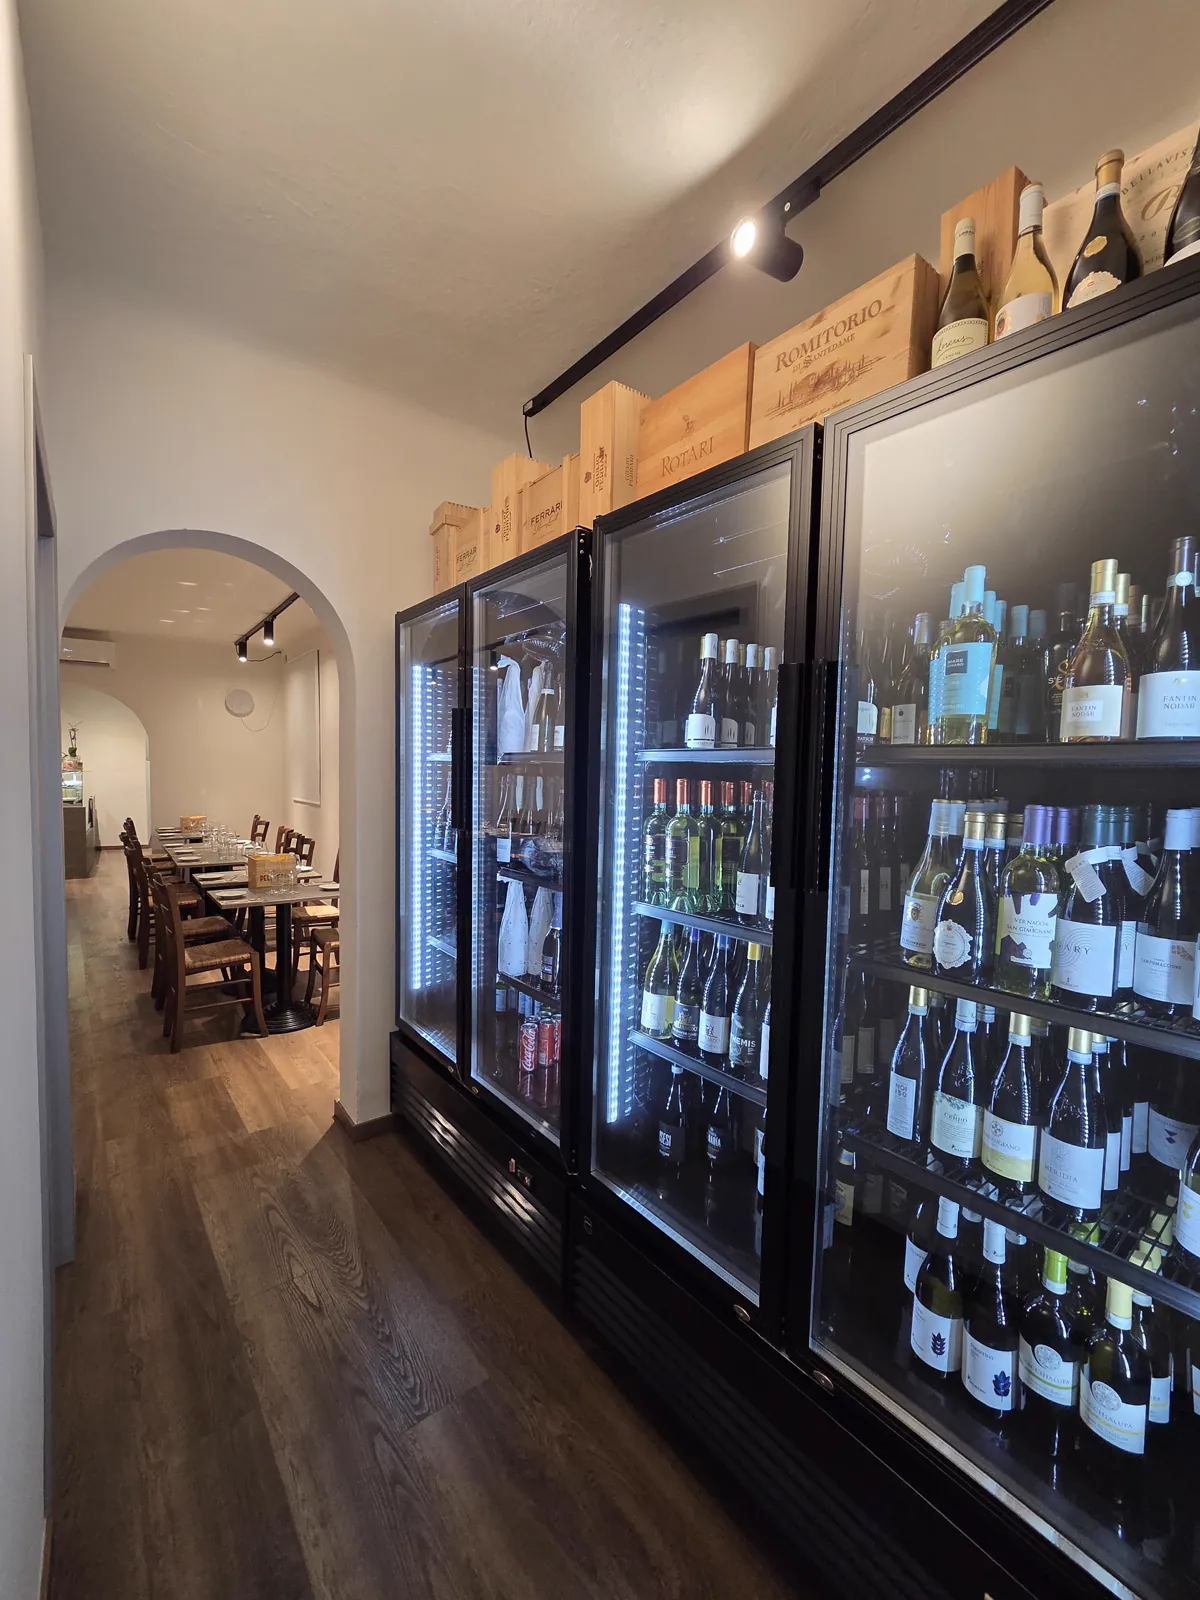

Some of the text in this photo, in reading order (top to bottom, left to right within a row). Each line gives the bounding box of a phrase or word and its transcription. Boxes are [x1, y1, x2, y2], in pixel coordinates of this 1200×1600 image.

[1121, 147, 1194, 195] BELLAVIS
[775, 299, 883, 373] ROMITORIO
[800, 333, 856, 374] SANTEDAME
[660, 436, 714, 478] ROTARI
[530, 500, 563, 526] FERRARI
[456, 546, 477, 564] FERRAR
[1163, 695, 1197, 703] FANTIN
[1056, 941, 1091, 955] GARY
[1044, 1164, 1078, 1184] MERIDIA
